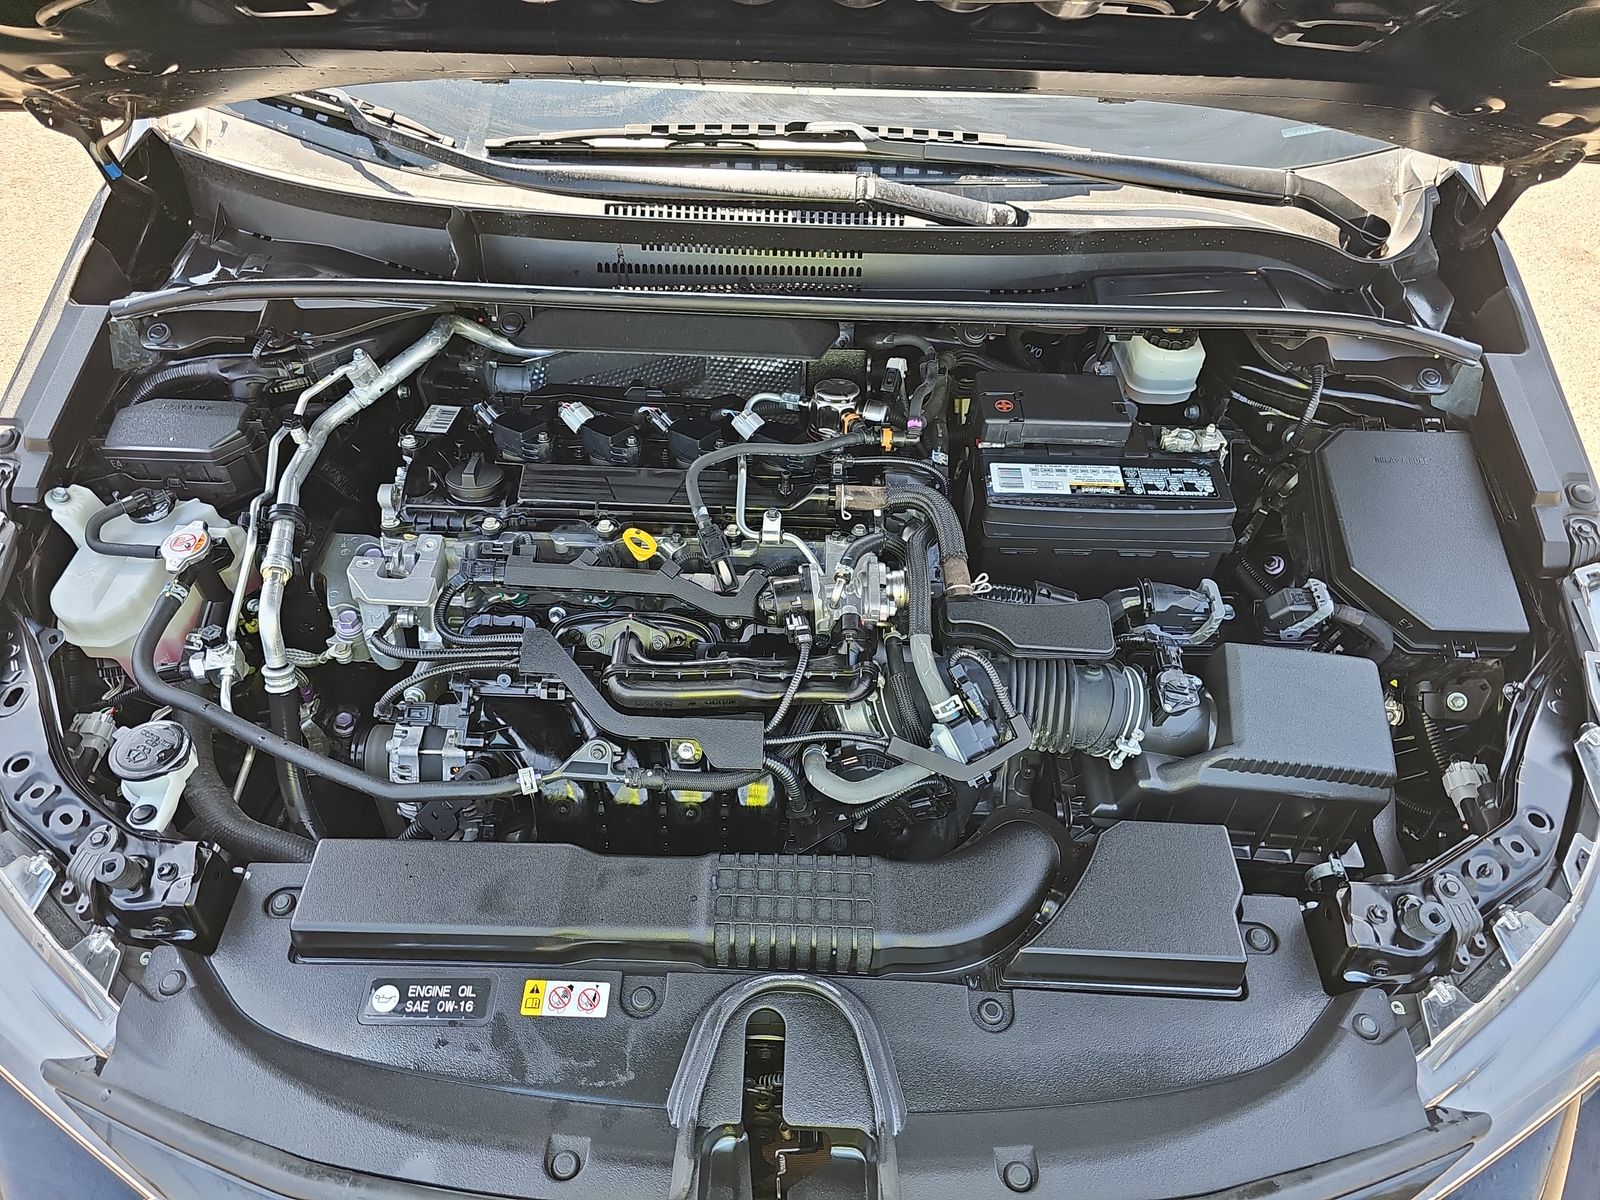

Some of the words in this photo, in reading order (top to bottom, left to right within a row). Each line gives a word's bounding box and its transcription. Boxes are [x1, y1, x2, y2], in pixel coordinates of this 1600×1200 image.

[408, 985, 451, 998] ENGINE
[458, 985, 477, 998] OIL
[405, 1000, 430, 1013] SAE
[436, 1000, 474, 1013] 0W-16
